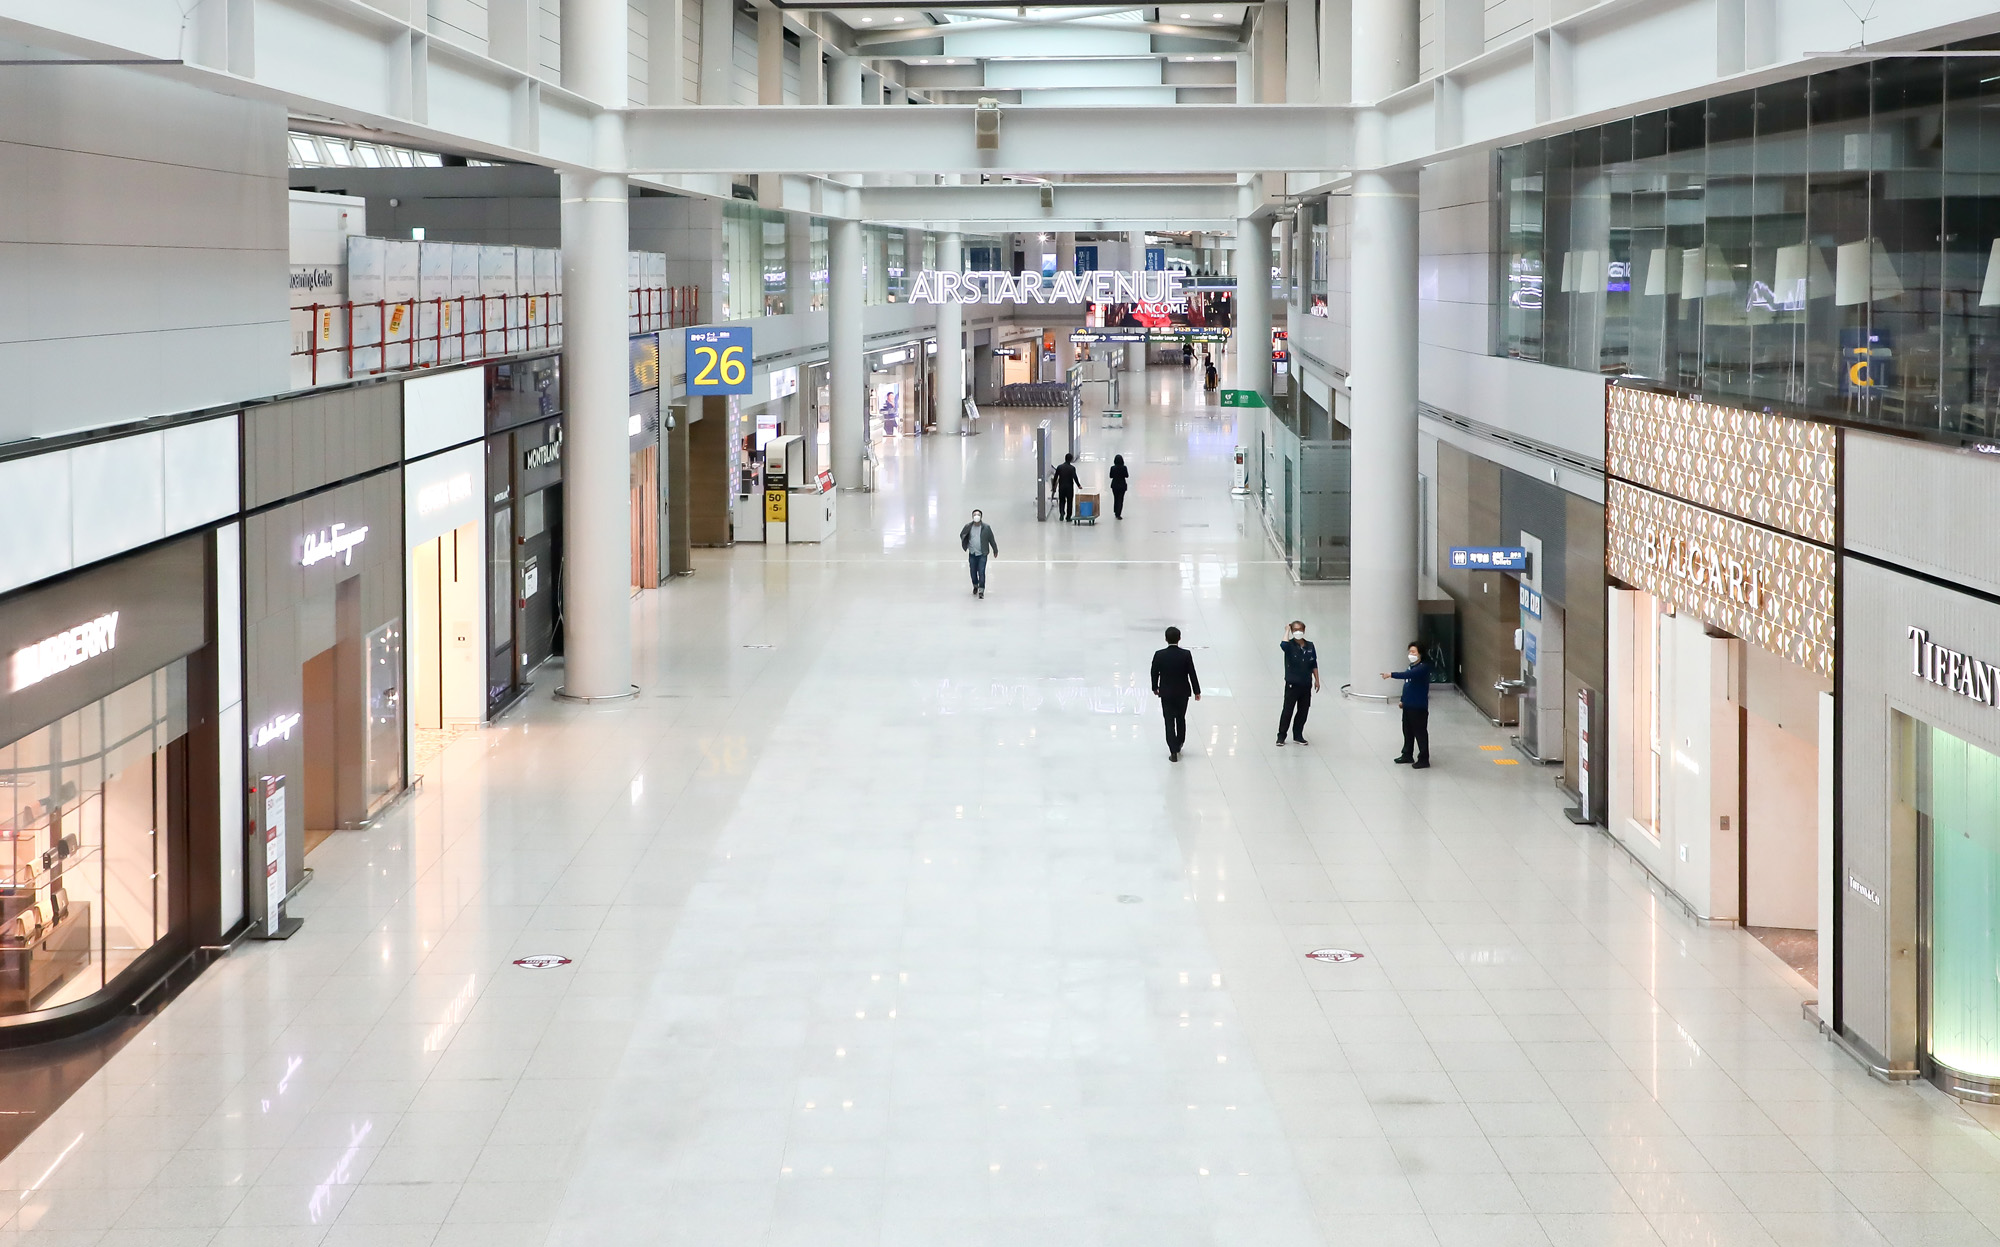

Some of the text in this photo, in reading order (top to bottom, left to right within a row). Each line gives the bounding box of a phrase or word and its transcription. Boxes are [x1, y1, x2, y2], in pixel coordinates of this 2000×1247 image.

[908, 270, 1187, 304] AIRSTAR AVENUE
[694, 346, 746, 385] 26
[527, 441, 560, 470] MONTBLANC
[1645, 528, 1759, 610] BVLGARI
